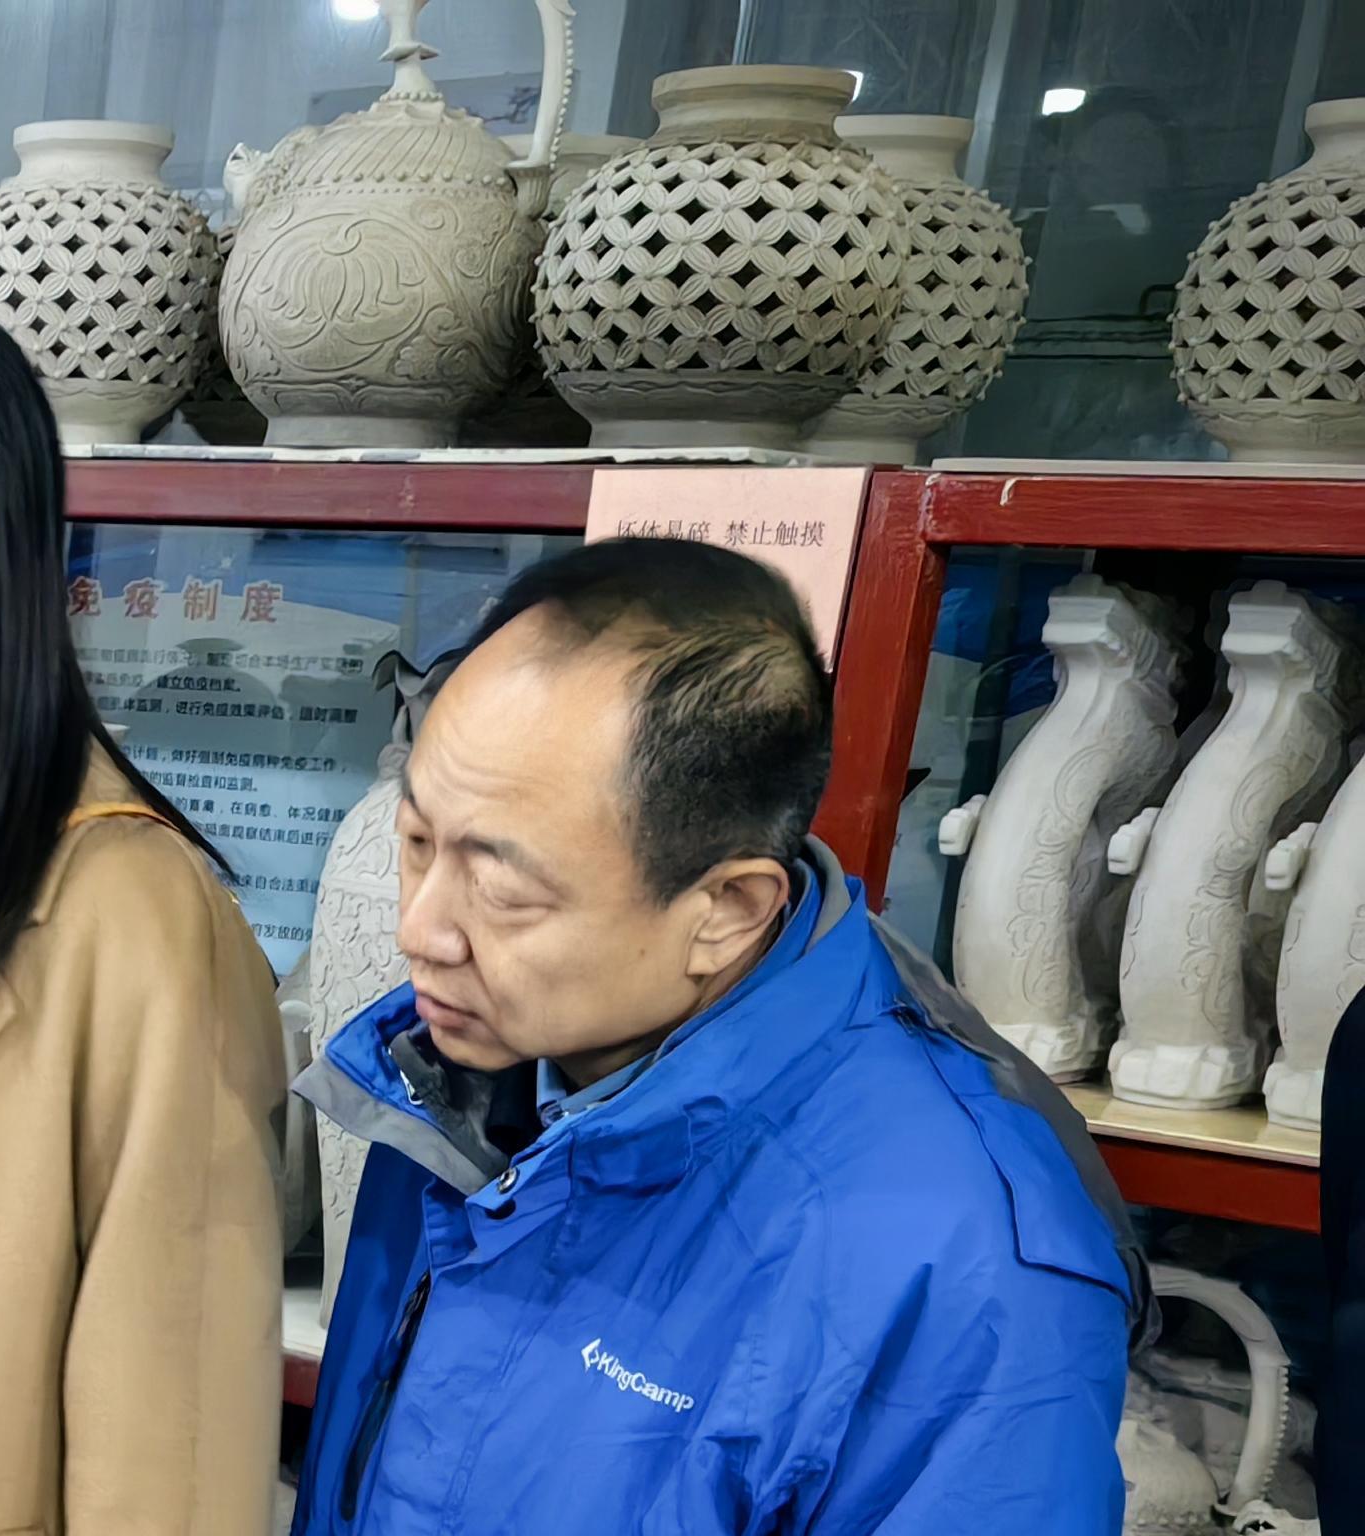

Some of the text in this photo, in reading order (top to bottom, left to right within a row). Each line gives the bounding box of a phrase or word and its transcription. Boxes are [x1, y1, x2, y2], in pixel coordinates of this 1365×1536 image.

[724, 519, 826, 548] 禁止触摸
[69, 575, 284, 623] 免疫制度
[596, 1350, 695, 1413] KingCamp
